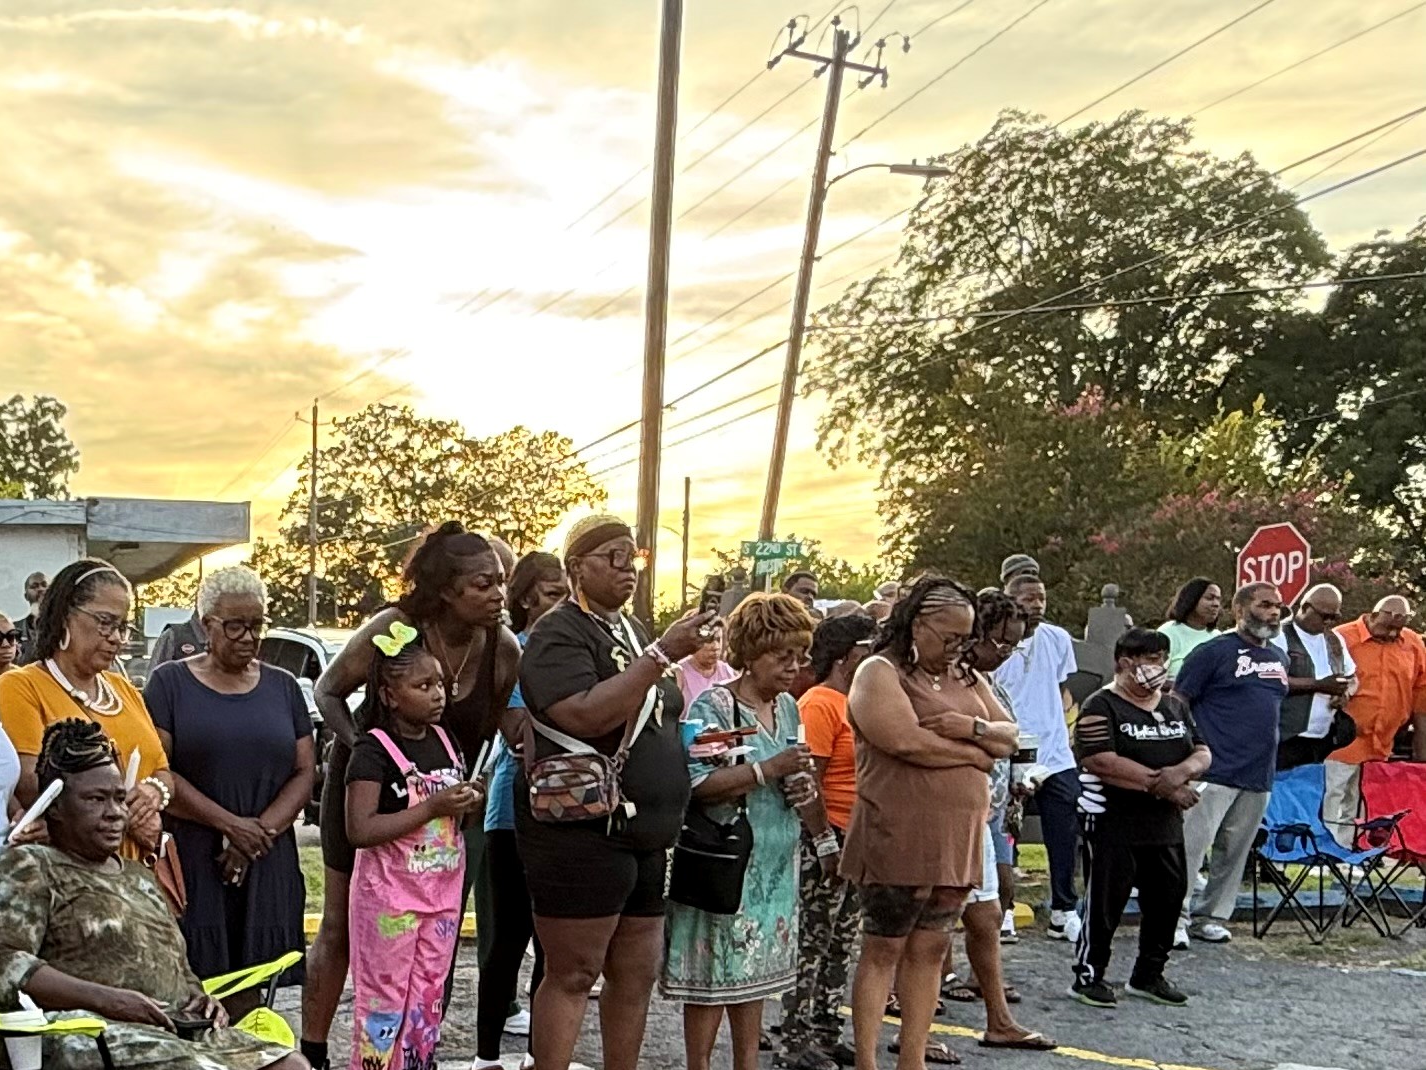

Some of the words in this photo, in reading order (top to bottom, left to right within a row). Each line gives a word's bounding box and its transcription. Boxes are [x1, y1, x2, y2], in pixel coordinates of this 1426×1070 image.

[742, 543, 750, 555] S
[786, 543, 798, 557] ST
[1241, 550, 1303, 587] STOP
